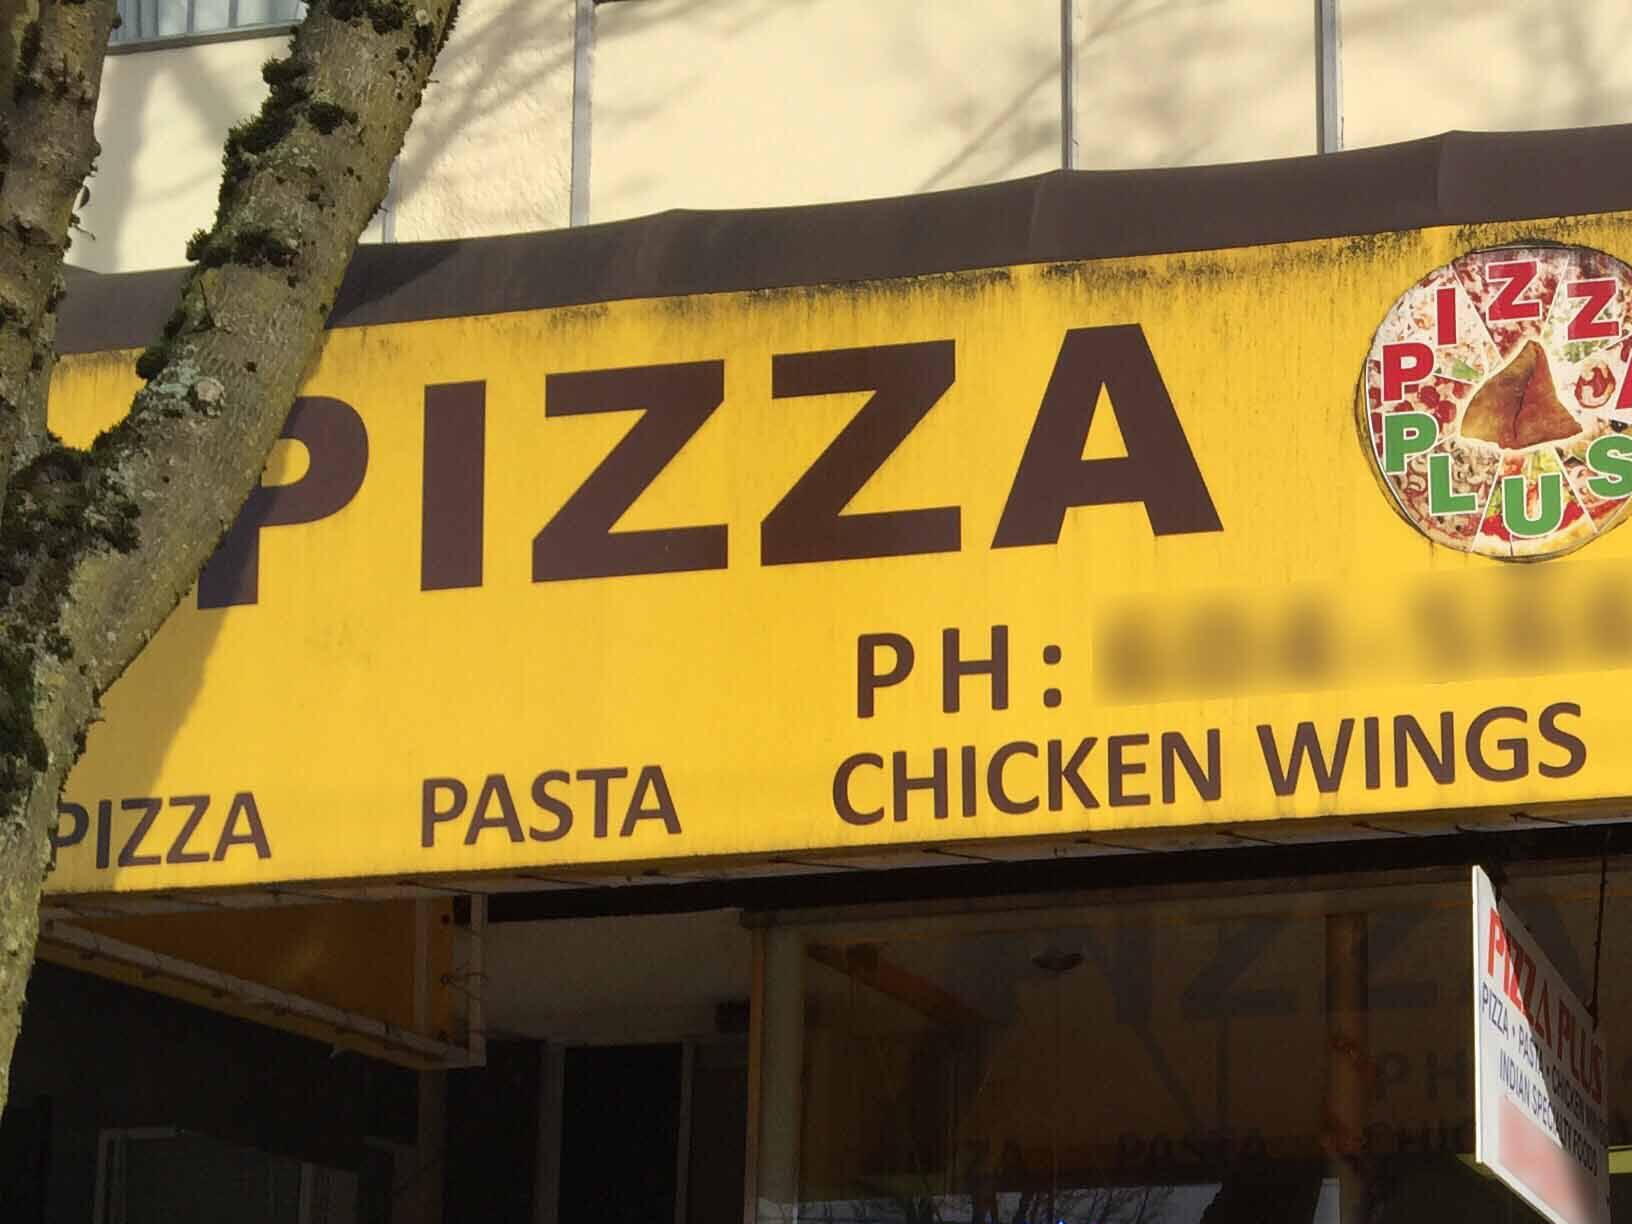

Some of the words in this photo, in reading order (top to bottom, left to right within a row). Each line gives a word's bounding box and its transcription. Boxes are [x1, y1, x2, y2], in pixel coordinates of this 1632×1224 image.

[196, 323, 1223, 610] PIZZA
[857, 624, 1062, 718] PH:
[421, 765, 681, 847] PASTA
[833, 728, 1224, 826] CHICKEN
[1256, 701, 1587, 797] WINGS
[51, 791, 272, 868] PIZZA
[1482, 982, 1509, 1040] PIZZA
[1519, 1024, 1543, 1074] PASTA
[1487, 907, 1552, 1048] PIZZA
[1557, 999, 1601, 1104] PLUS
[1500, 1047, 1531, 1109] INDIAN
